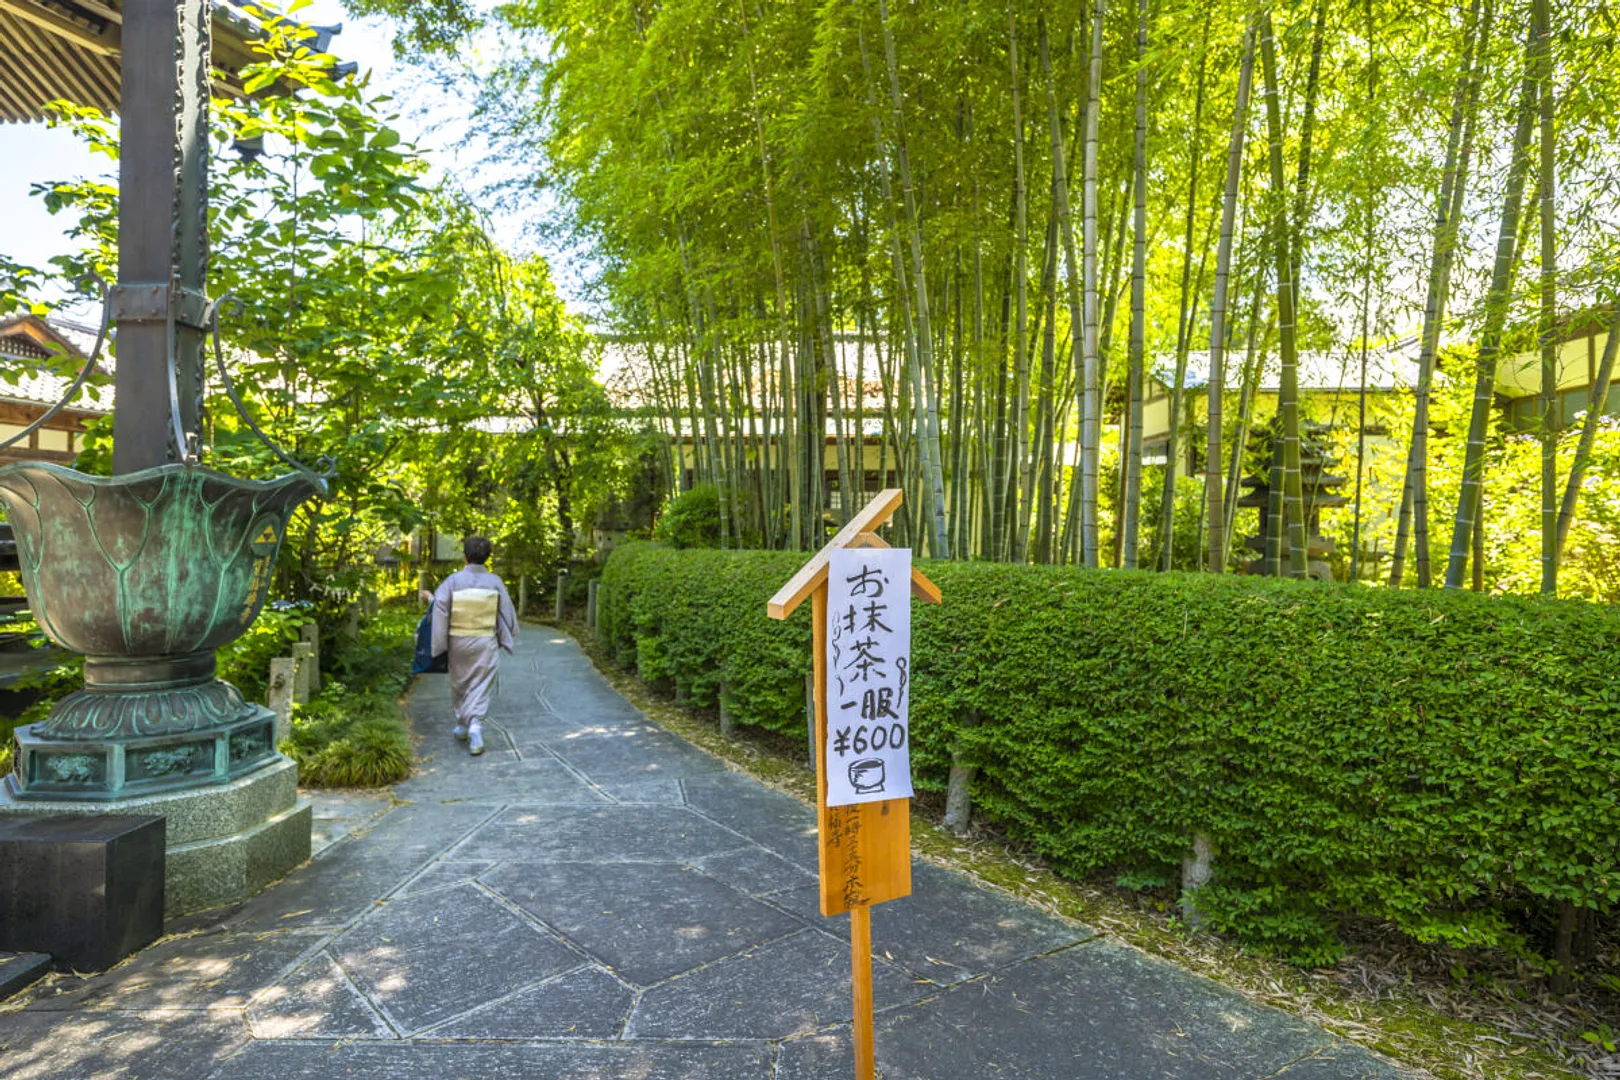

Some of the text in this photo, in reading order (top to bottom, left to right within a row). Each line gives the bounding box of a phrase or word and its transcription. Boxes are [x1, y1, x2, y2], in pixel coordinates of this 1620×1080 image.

[843, 564, 893, 682] お抹茶
[840, 687, 900, 721] 一服
[833, 723, 906, 758] ¥600
